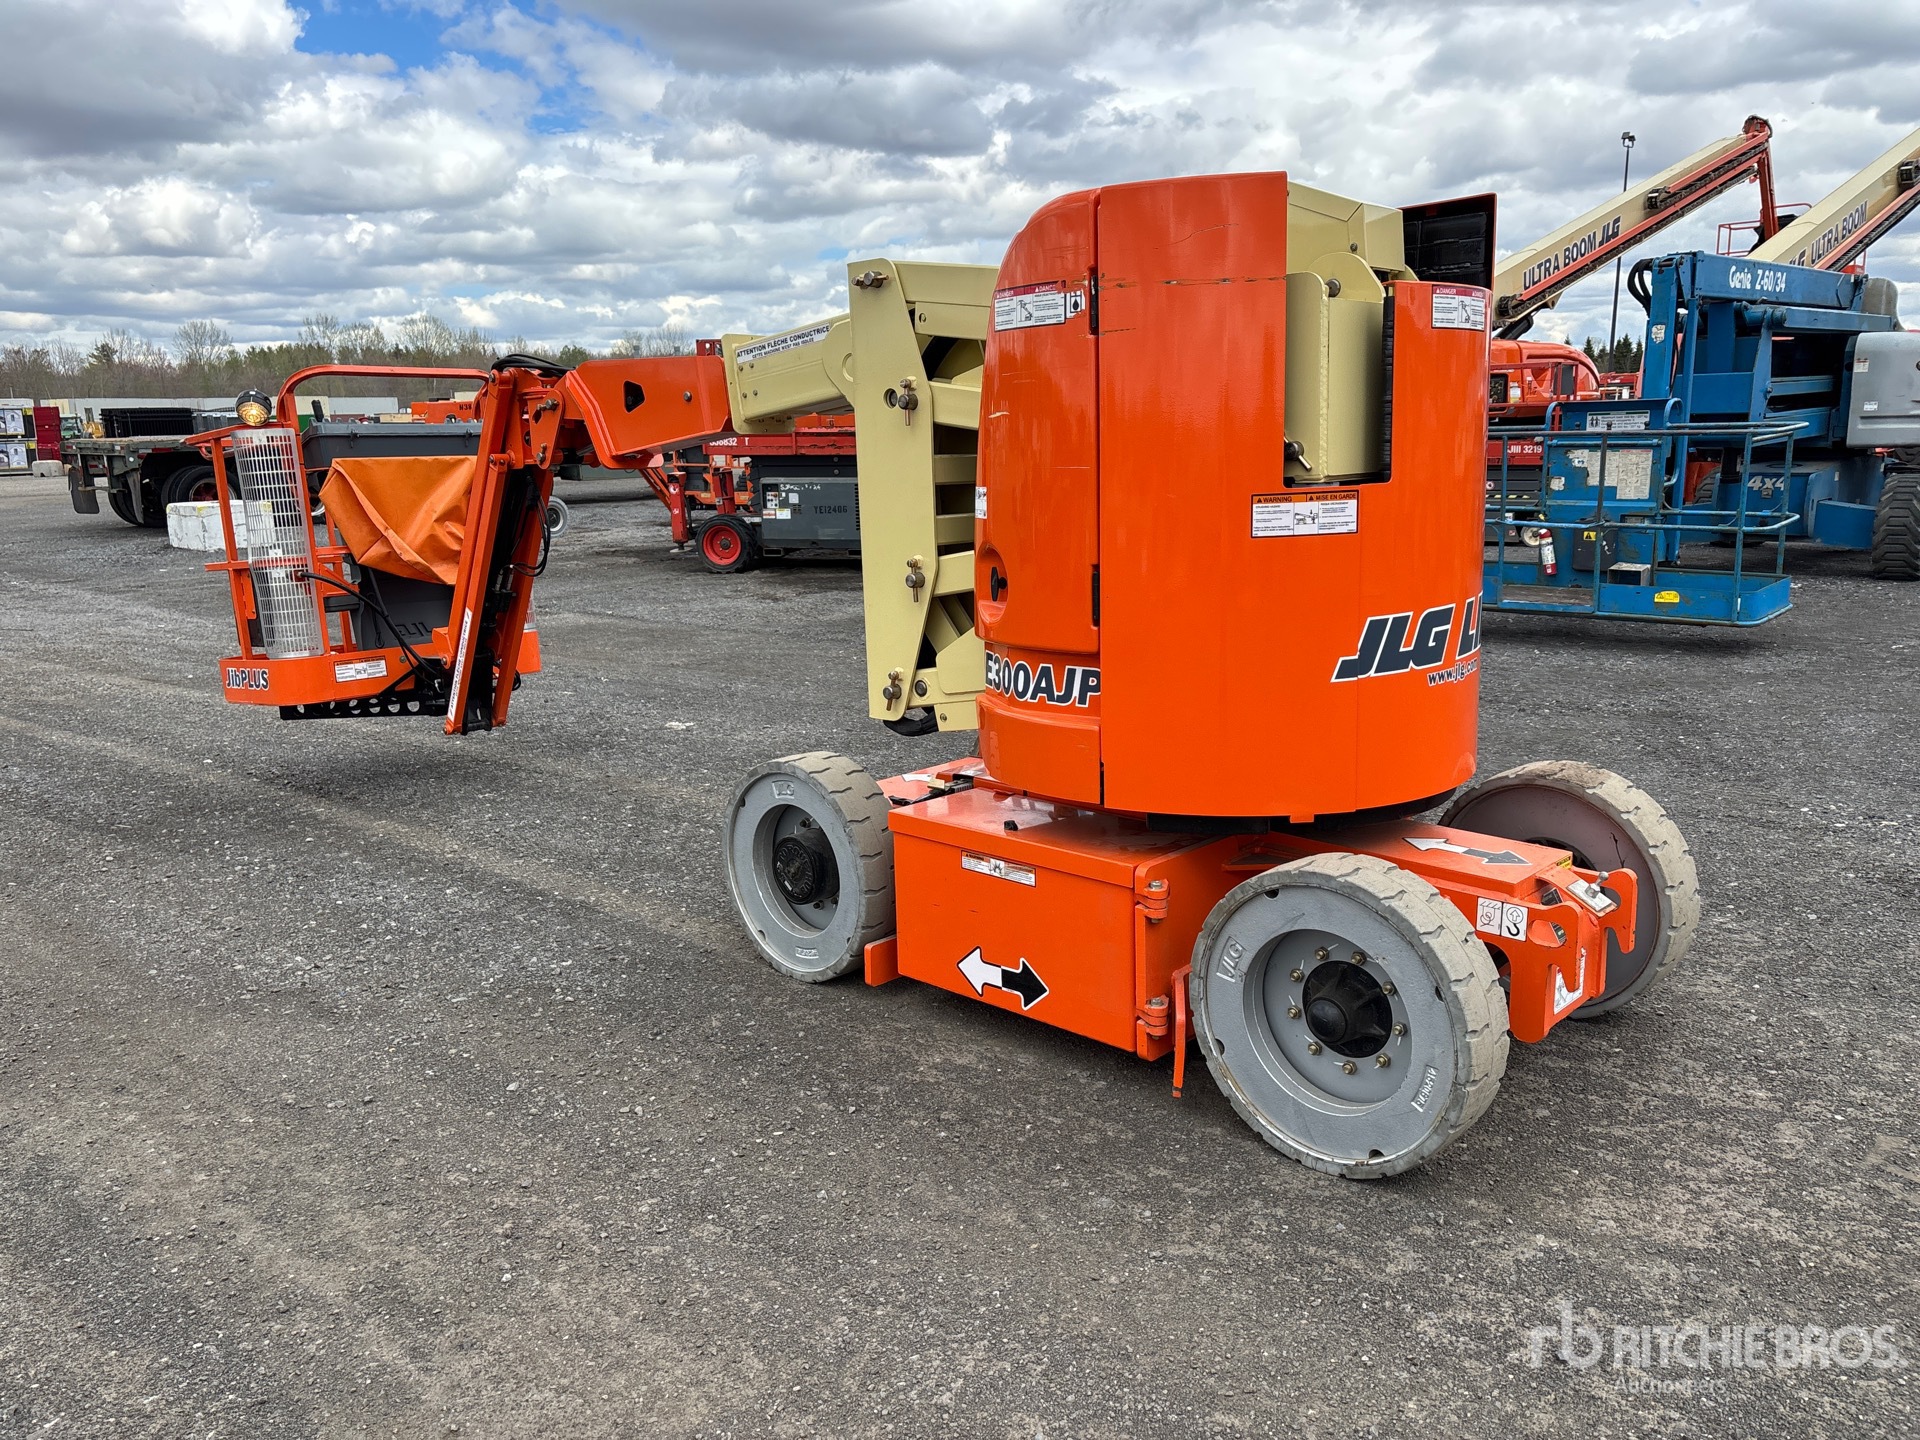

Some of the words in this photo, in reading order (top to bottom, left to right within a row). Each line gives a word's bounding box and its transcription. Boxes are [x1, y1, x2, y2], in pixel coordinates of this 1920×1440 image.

[1811, 224, 1839, 265] ULTRA
[1842, 200, 1868, 240] BOOM
[1523, 253, 1560, 291] ULTRA
[1563, 230, 1597, 268] BOOM
[1598, 215, 1621, 248] JLG
[1729, 265, 1751, 289] Genie
[1755, 269, 1787, 293] Z-60/34
[737, 344, 767, 358] ATTENTION
[789, 325, 830, 342] CONDUCTRICE
[1523, 445, 1543, 454] 3219
[1330, 603, 1456, 683] JLG
[225, 666, 270, 691] JibPLUS
